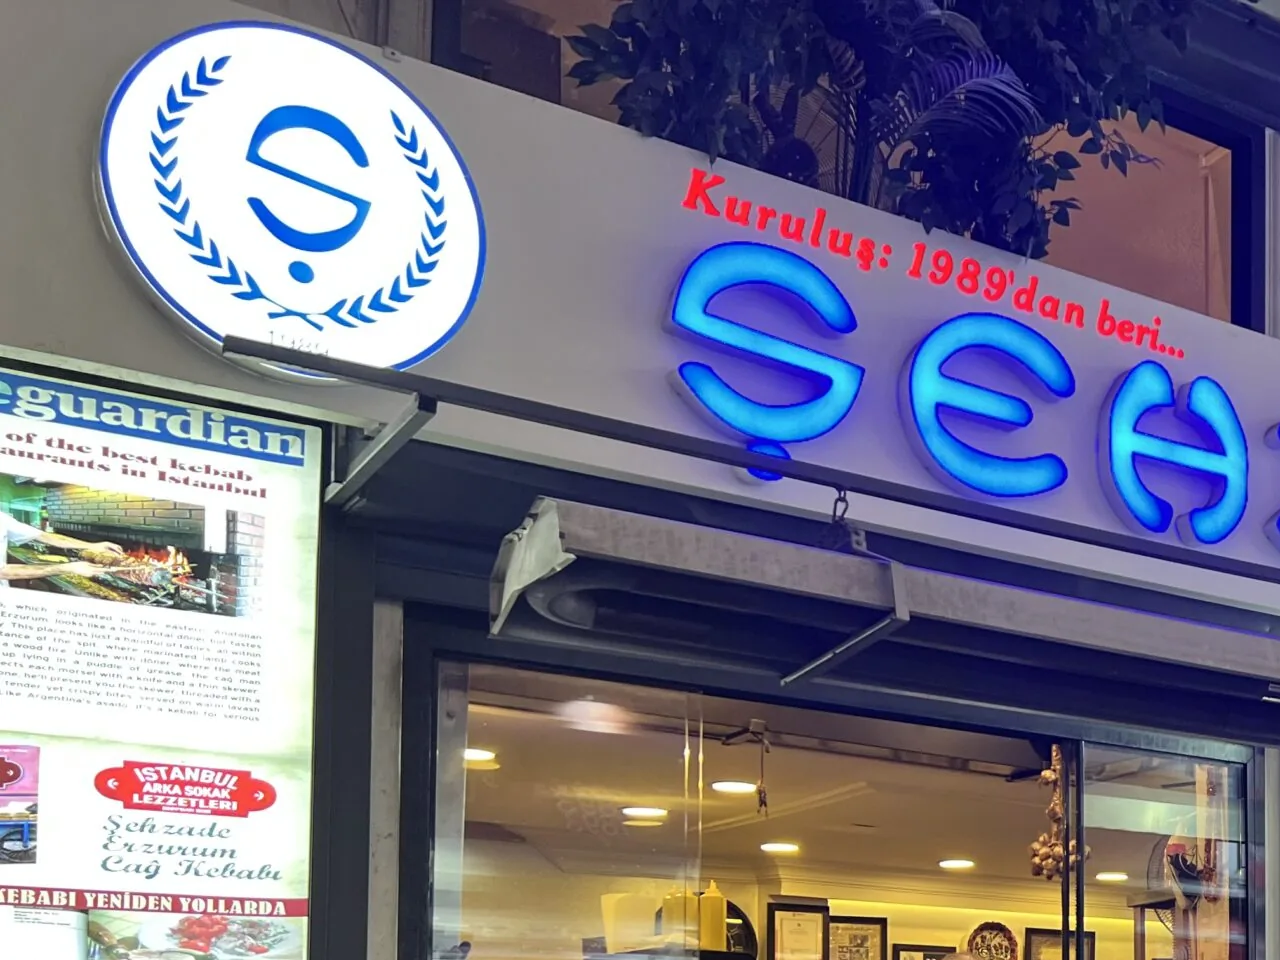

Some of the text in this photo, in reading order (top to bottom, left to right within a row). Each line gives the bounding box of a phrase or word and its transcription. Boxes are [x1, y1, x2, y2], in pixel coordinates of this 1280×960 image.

[682, 168, 1185, 359] Kuruluş: 1989'dan beri...
[5, 432, 253, 482] of the best kebab
[121, 464, 146, 478] in
[158, 470, 267, 499] Istanbul
[143, 783, 231, 799] ARKA SOKAK
[76, 890, 173, 912] YENİDEN
[179, 896, 286, 916] YOLLARDA
